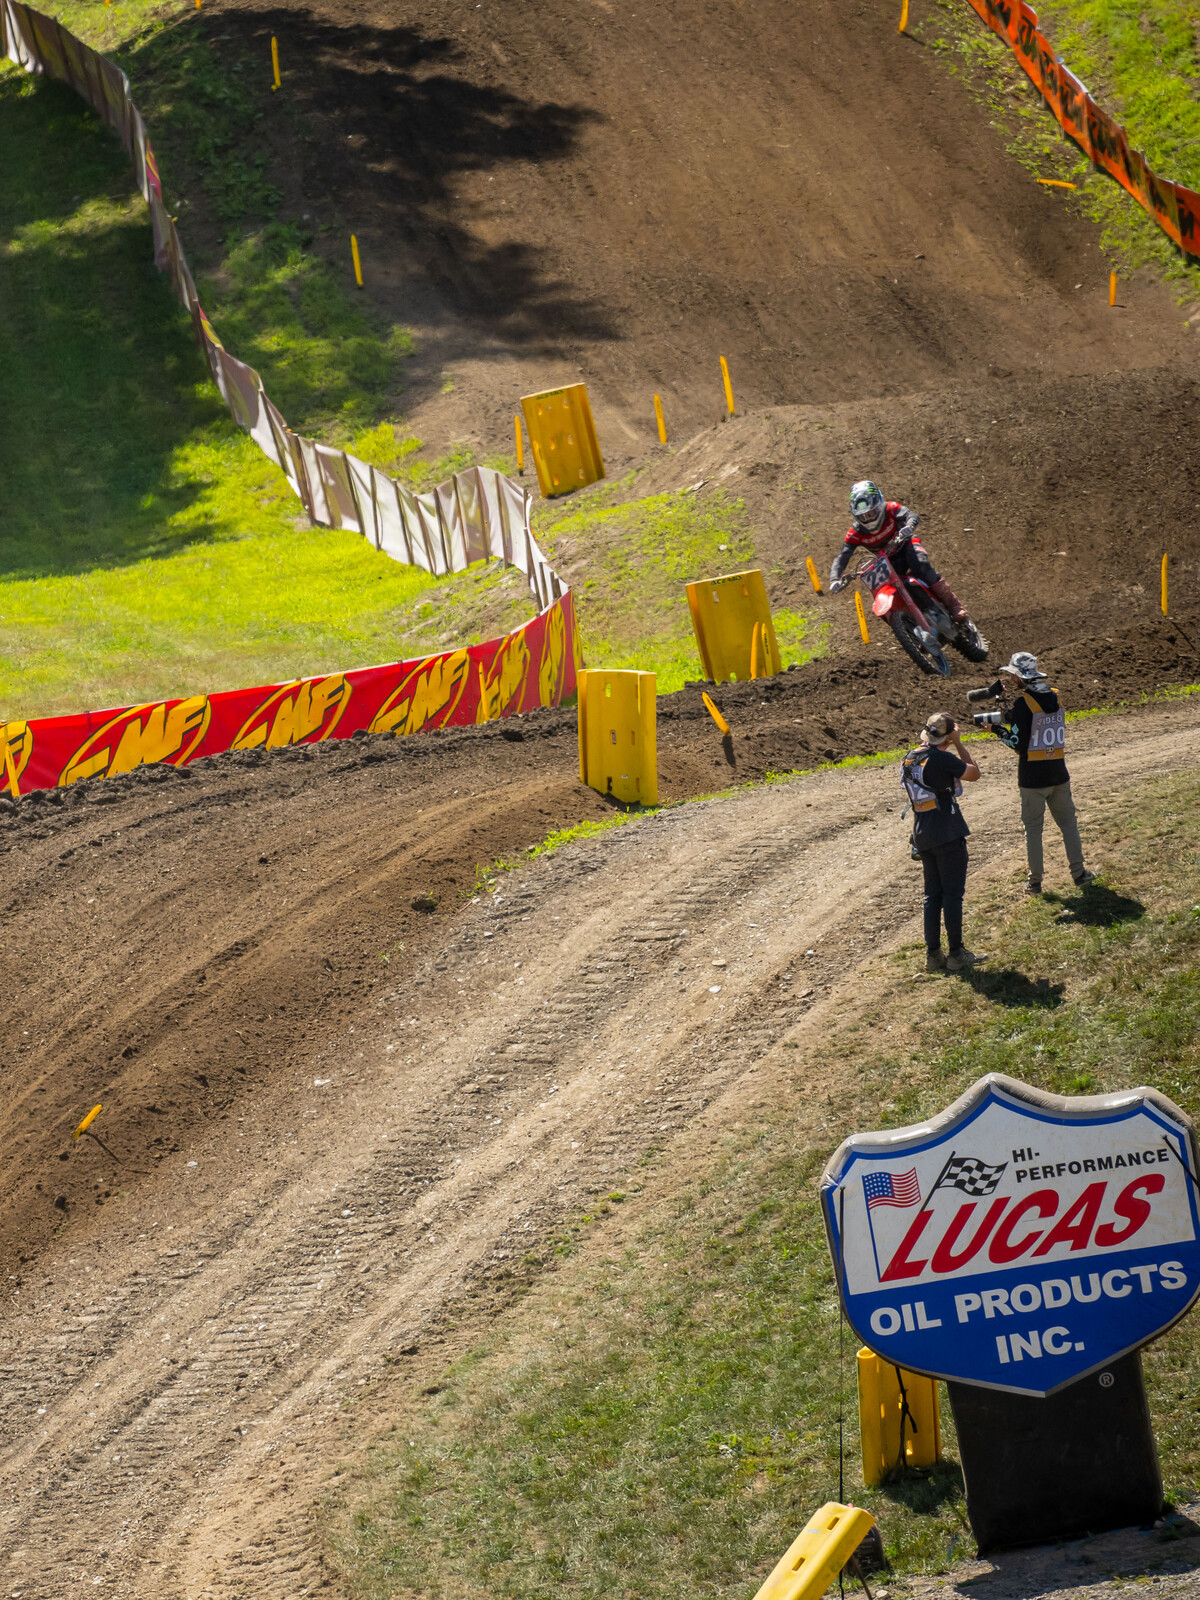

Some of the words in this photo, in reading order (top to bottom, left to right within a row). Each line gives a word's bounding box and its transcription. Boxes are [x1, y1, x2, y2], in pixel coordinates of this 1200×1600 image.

[866, 563, 891, 590] 23
[1031, 726, 1065, 747] 100
[1012, 1147, 1040, 1164] HI-
[1016, 1148, 1169, 1183] PERFORMANCE
[879, 1173, 1166, 1283] LUCAS
[869, 1301, 942, 1337] OIL
[954, 1261, 1188, 1324] PRODUCTS
[995, 1326, 1086, 1364] INC.
